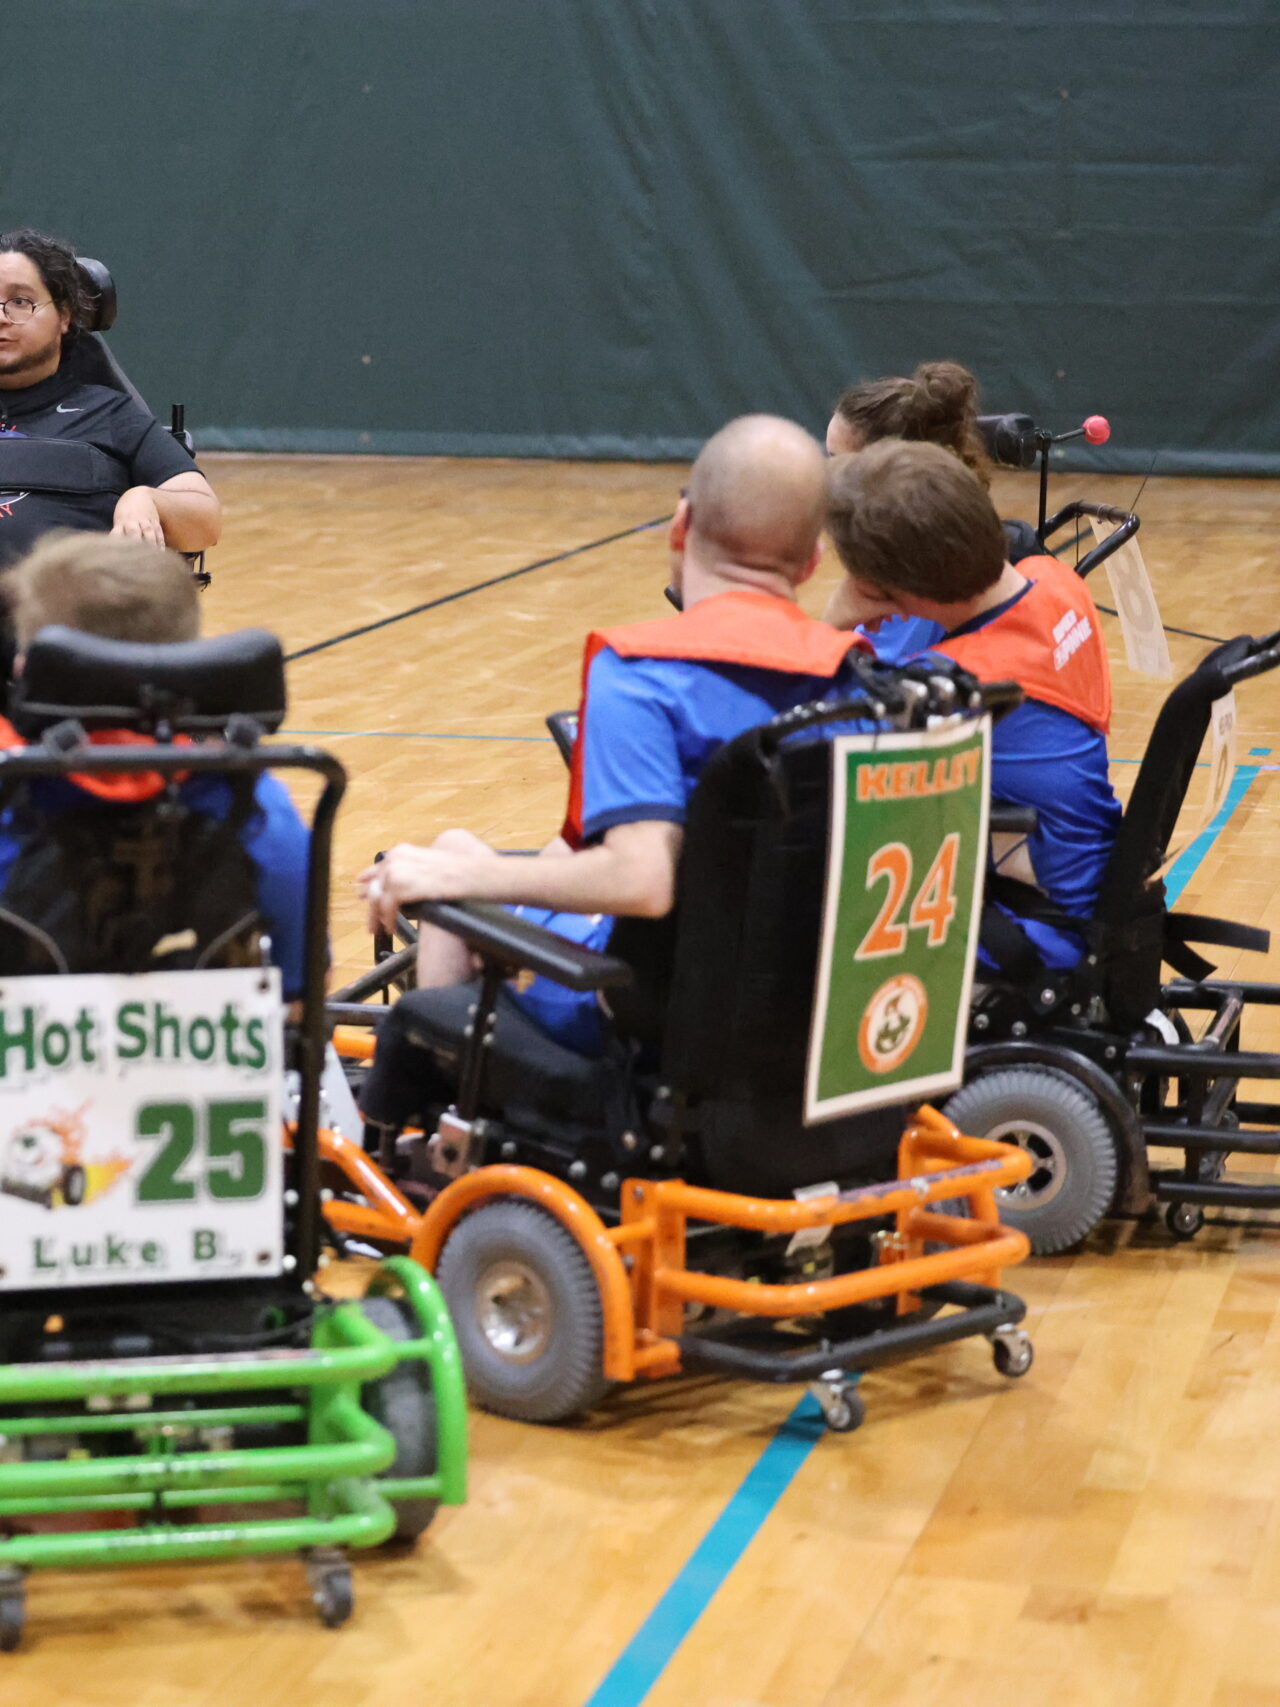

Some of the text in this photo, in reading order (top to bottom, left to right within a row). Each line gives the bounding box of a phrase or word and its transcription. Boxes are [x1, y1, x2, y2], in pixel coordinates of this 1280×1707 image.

[853, 832, 960, 961] 24
[116, 1002, 267, 1069] Shots
[136, 1100, 266, 1201] 25
[33, 1234, 158, 1269] Luke
